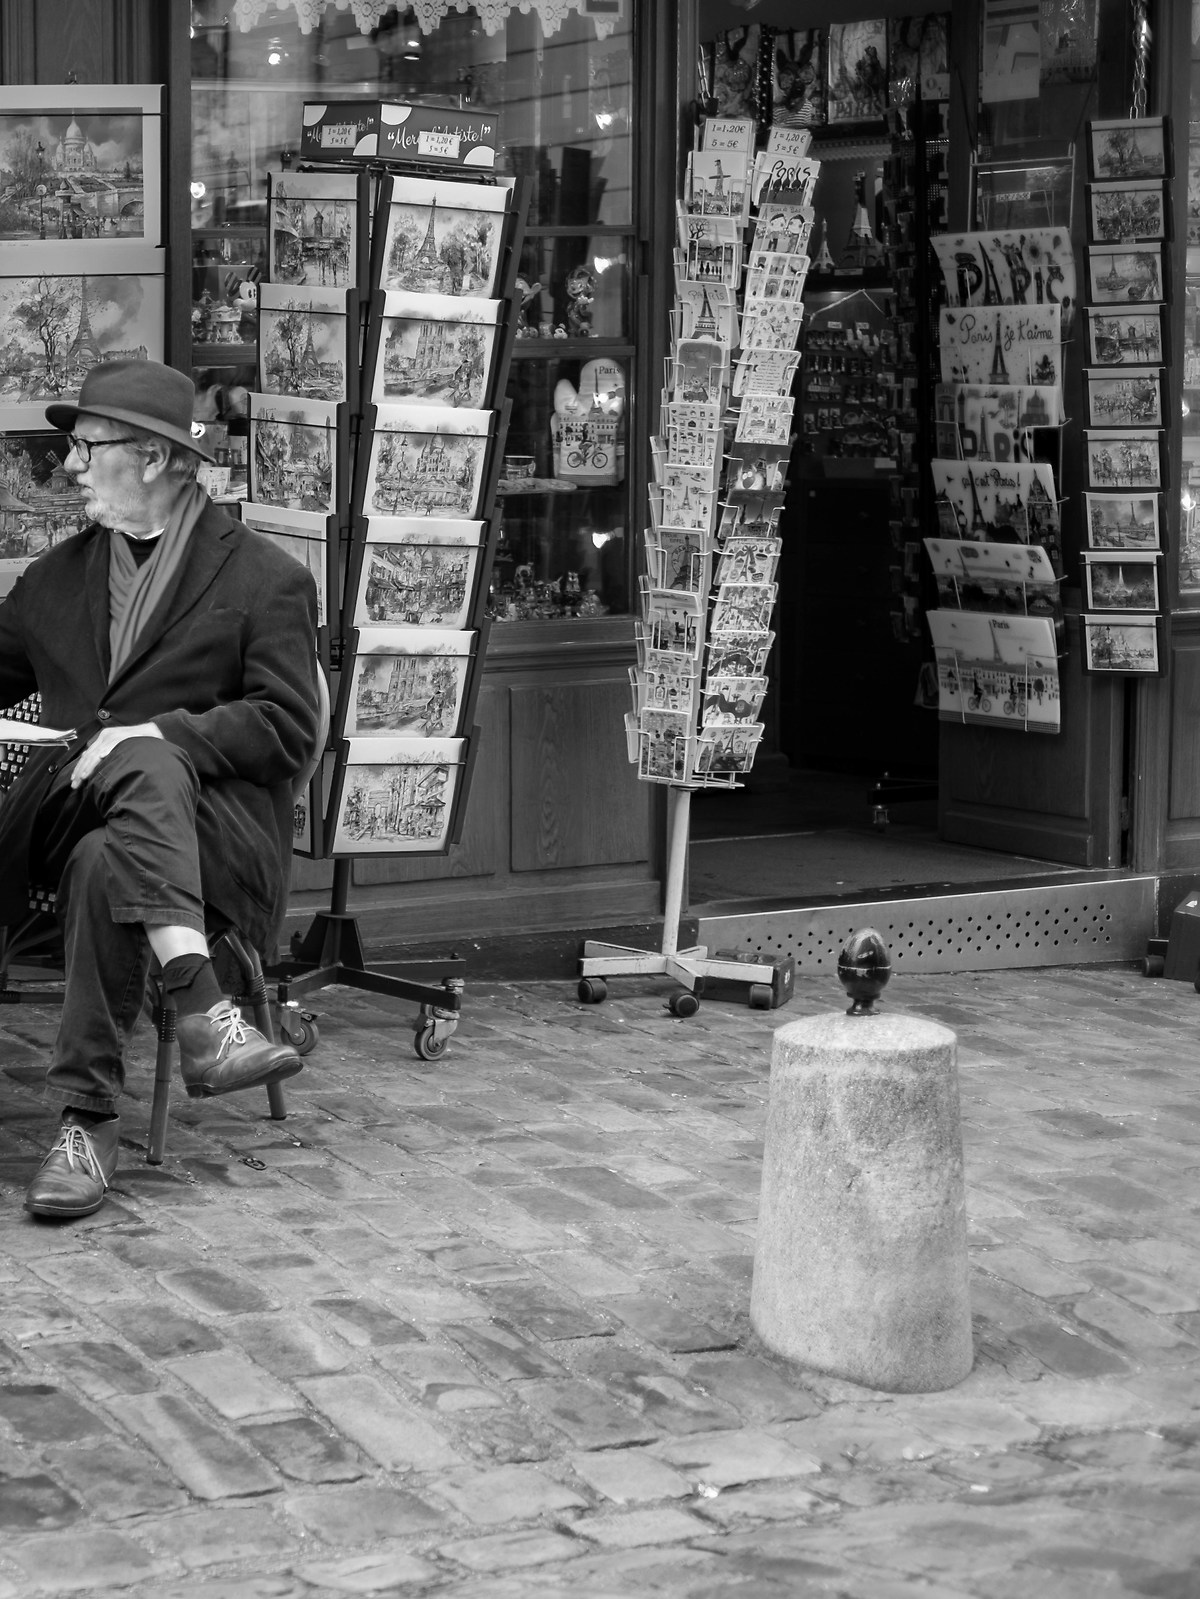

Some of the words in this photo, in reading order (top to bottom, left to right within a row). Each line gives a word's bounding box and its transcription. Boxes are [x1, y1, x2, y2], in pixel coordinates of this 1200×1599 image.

[786, 133, 799, 142] 1,20
[787, 145, 792, 153] 5
[960, 314, 993, 344] Paris
[1004, 325, 1015, 351] je
[1018, 319, 1053, 341] t'aime
[599, 366, 620, 374] Paris
[992, 619, 1010, 630] Paris
